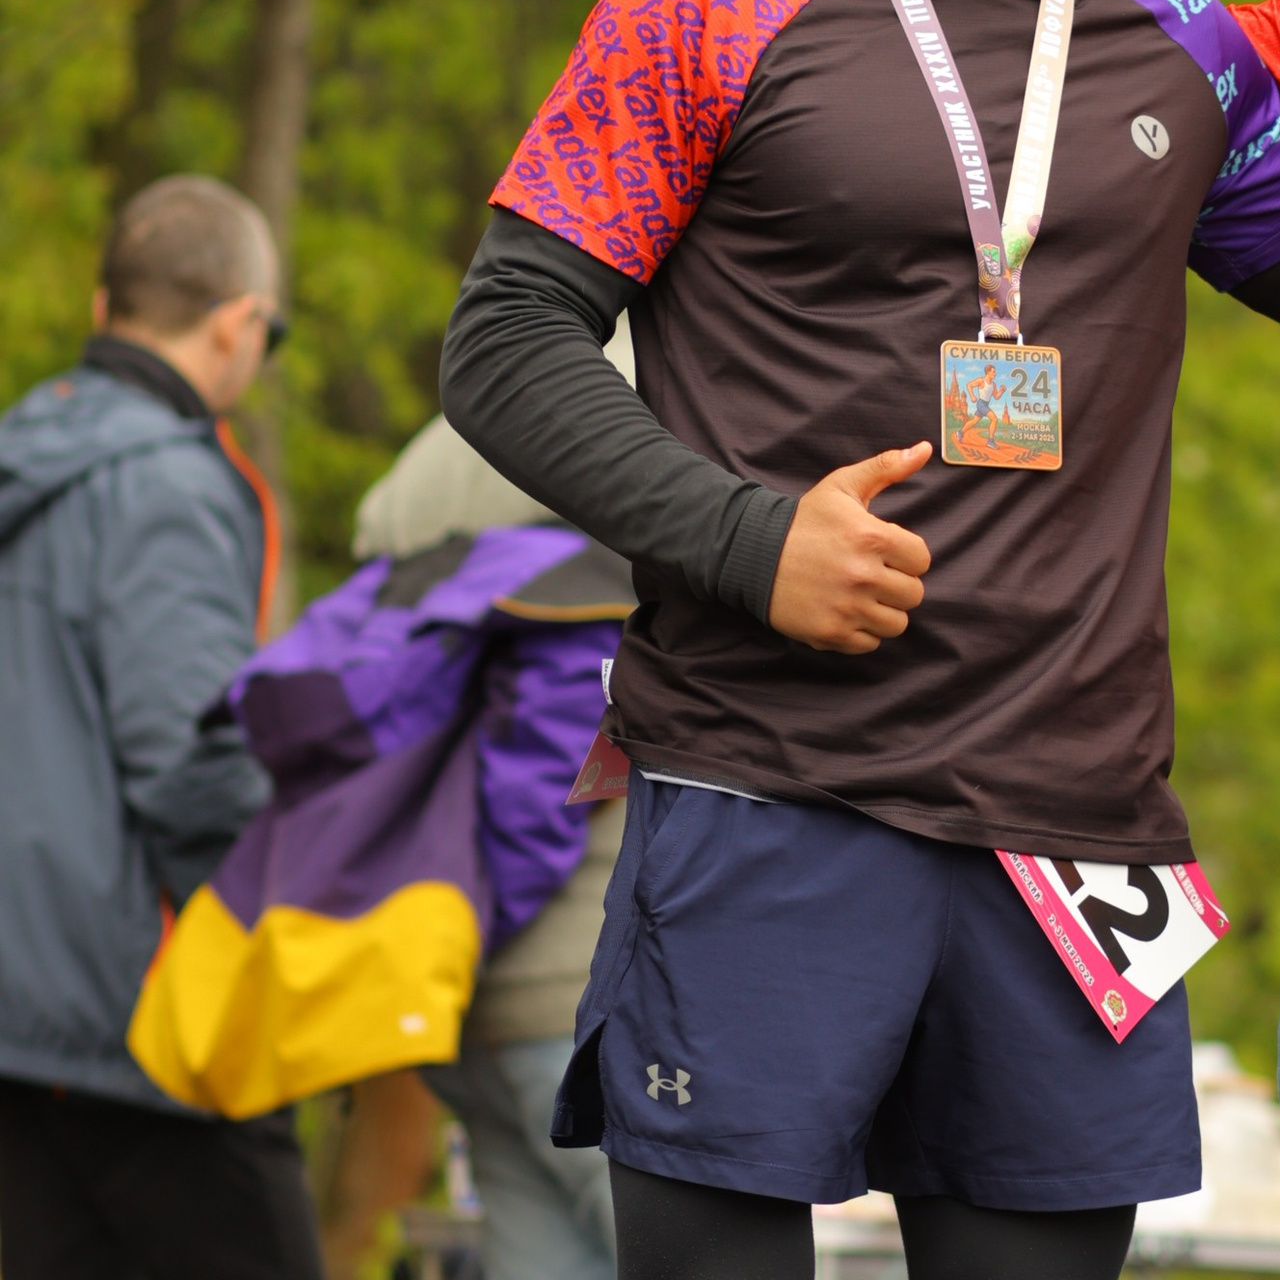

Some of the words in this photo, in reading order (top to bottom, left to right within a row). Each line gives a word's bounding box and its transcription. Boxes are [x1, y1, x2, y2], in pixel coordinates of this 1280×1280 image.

[915, 32, 960, 94] XXXIV
[944, 101, 991, 210] УЧАСТНИК
[950, 347, 999, 361] СУТКИ
[1005, 350, 1054, 364] БЕГОМ
[1010, 368, 1051, 399] 24
[1012, 401, 1051, 415] ЧАСА
[1017, 423, 1051, 432] МОСКВА
[1024, 432, 1038, 440] МАЯ
[1039, 433, 1055, 442] 2025
[1060, 934, 1077, 960] МАЯ
[1073, 955, 1095, 987] 2025
